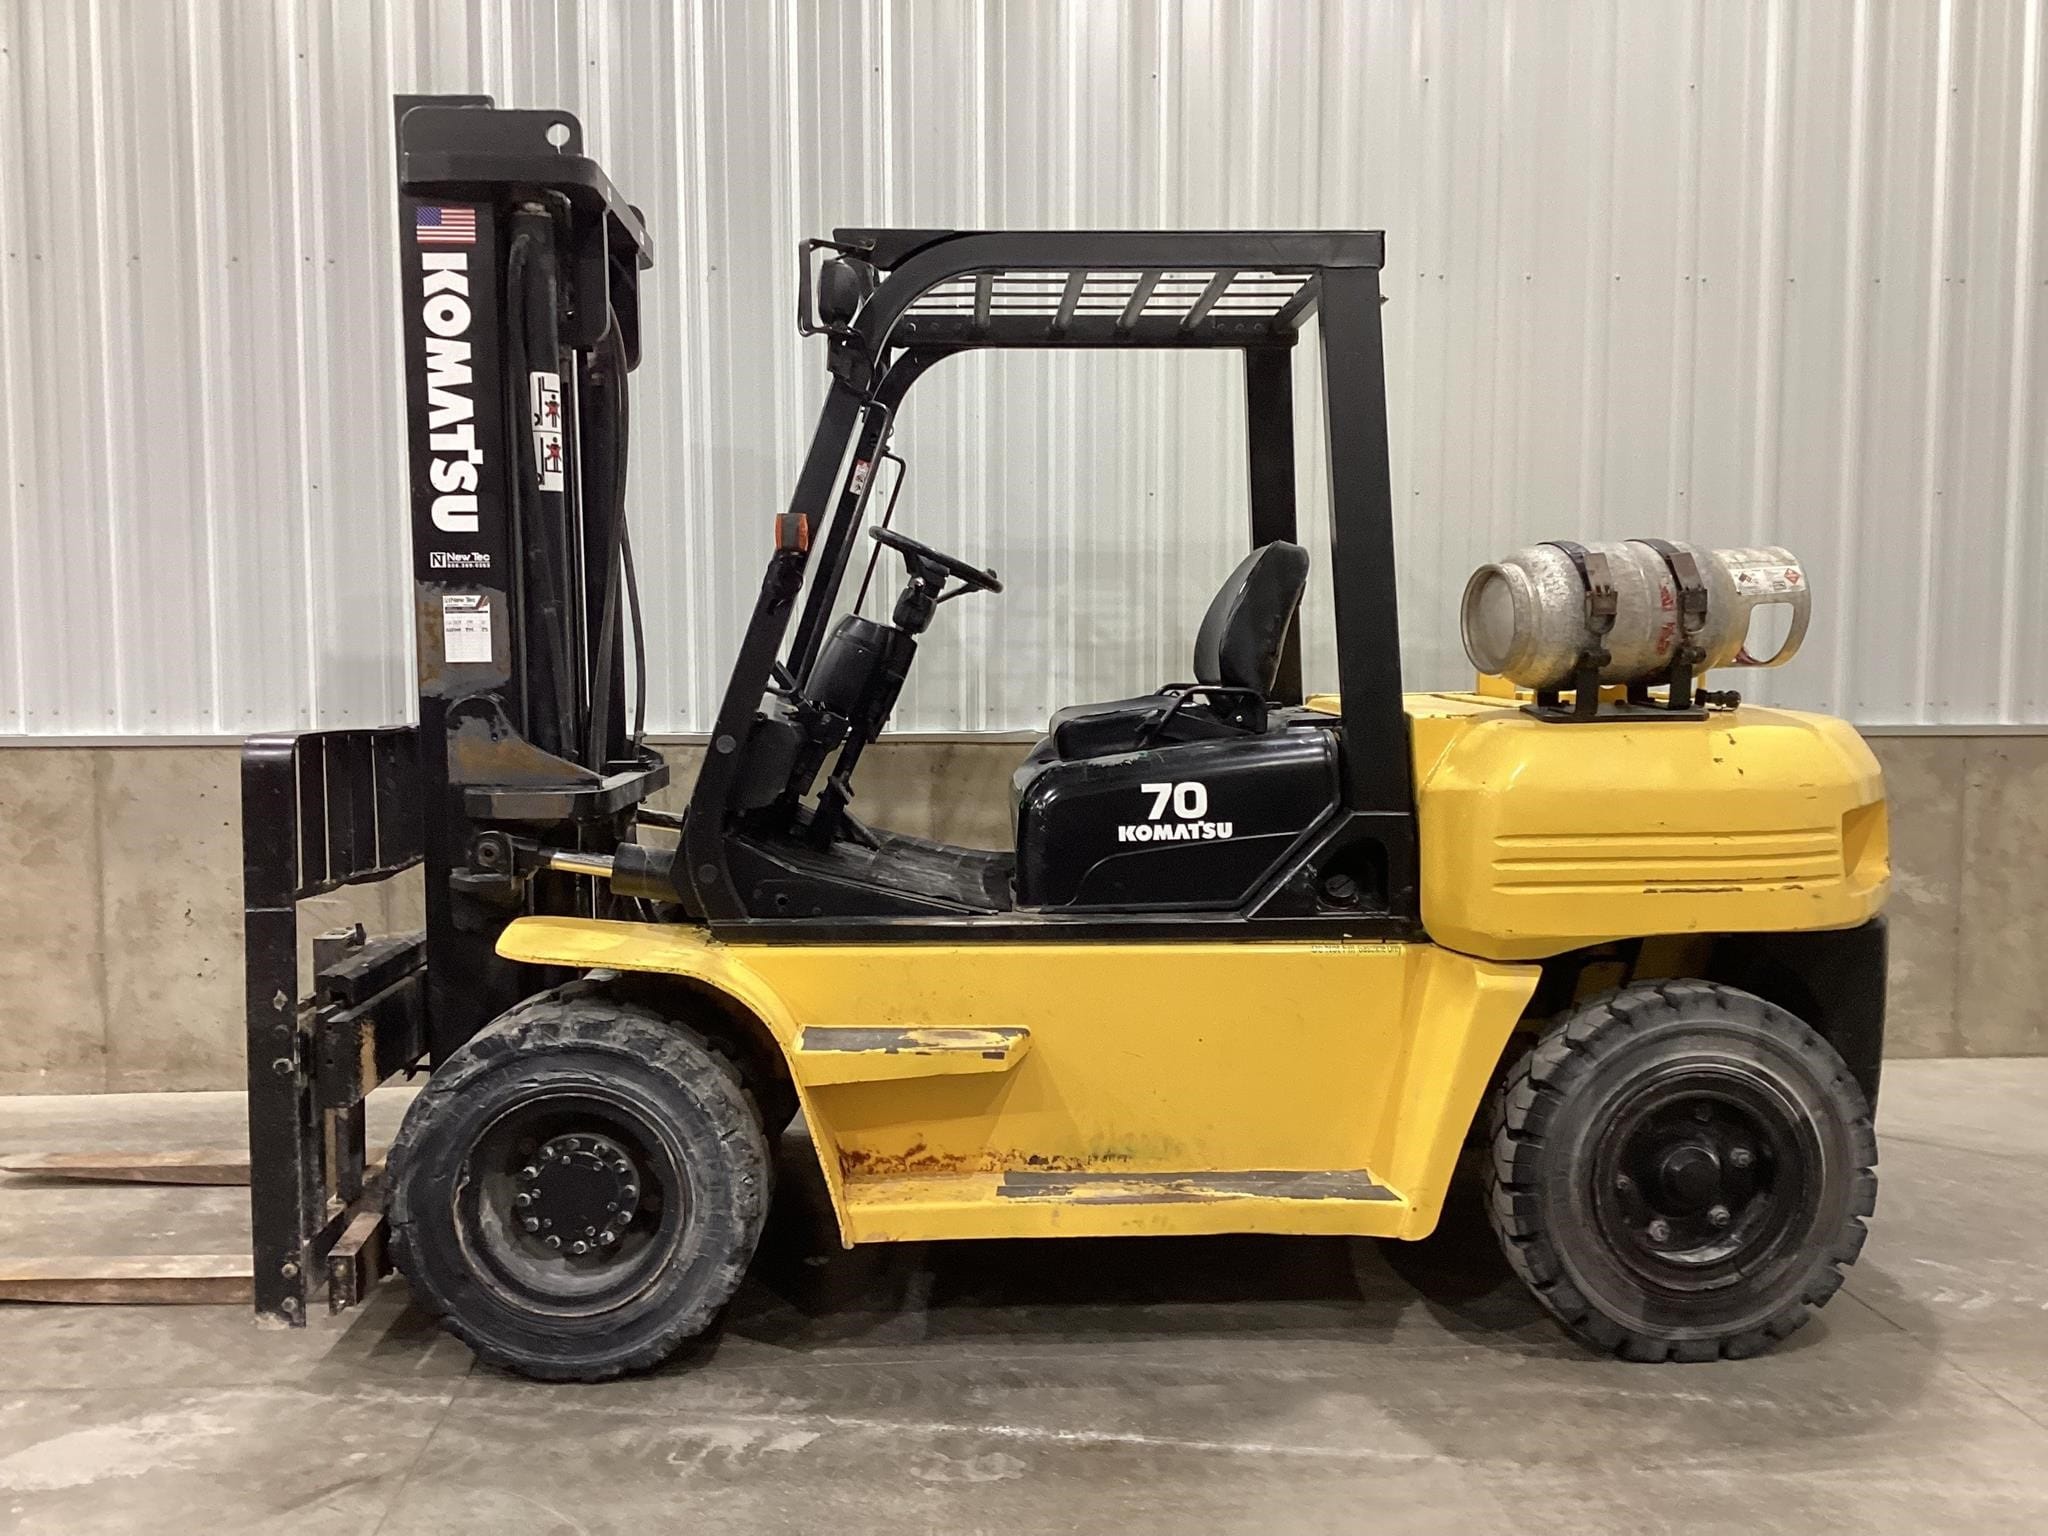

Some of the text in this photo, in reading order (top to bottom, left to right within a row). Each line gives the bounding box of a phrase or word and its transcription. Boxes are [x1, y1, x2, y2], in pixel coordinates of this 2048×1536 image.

[421, 252, 484, 532] KOMATSU
[446, 552, 491, 562] New Tec
[1140, 781, 1208, 820] 70
[1118, 820, 1233, 842] KOMATSU
